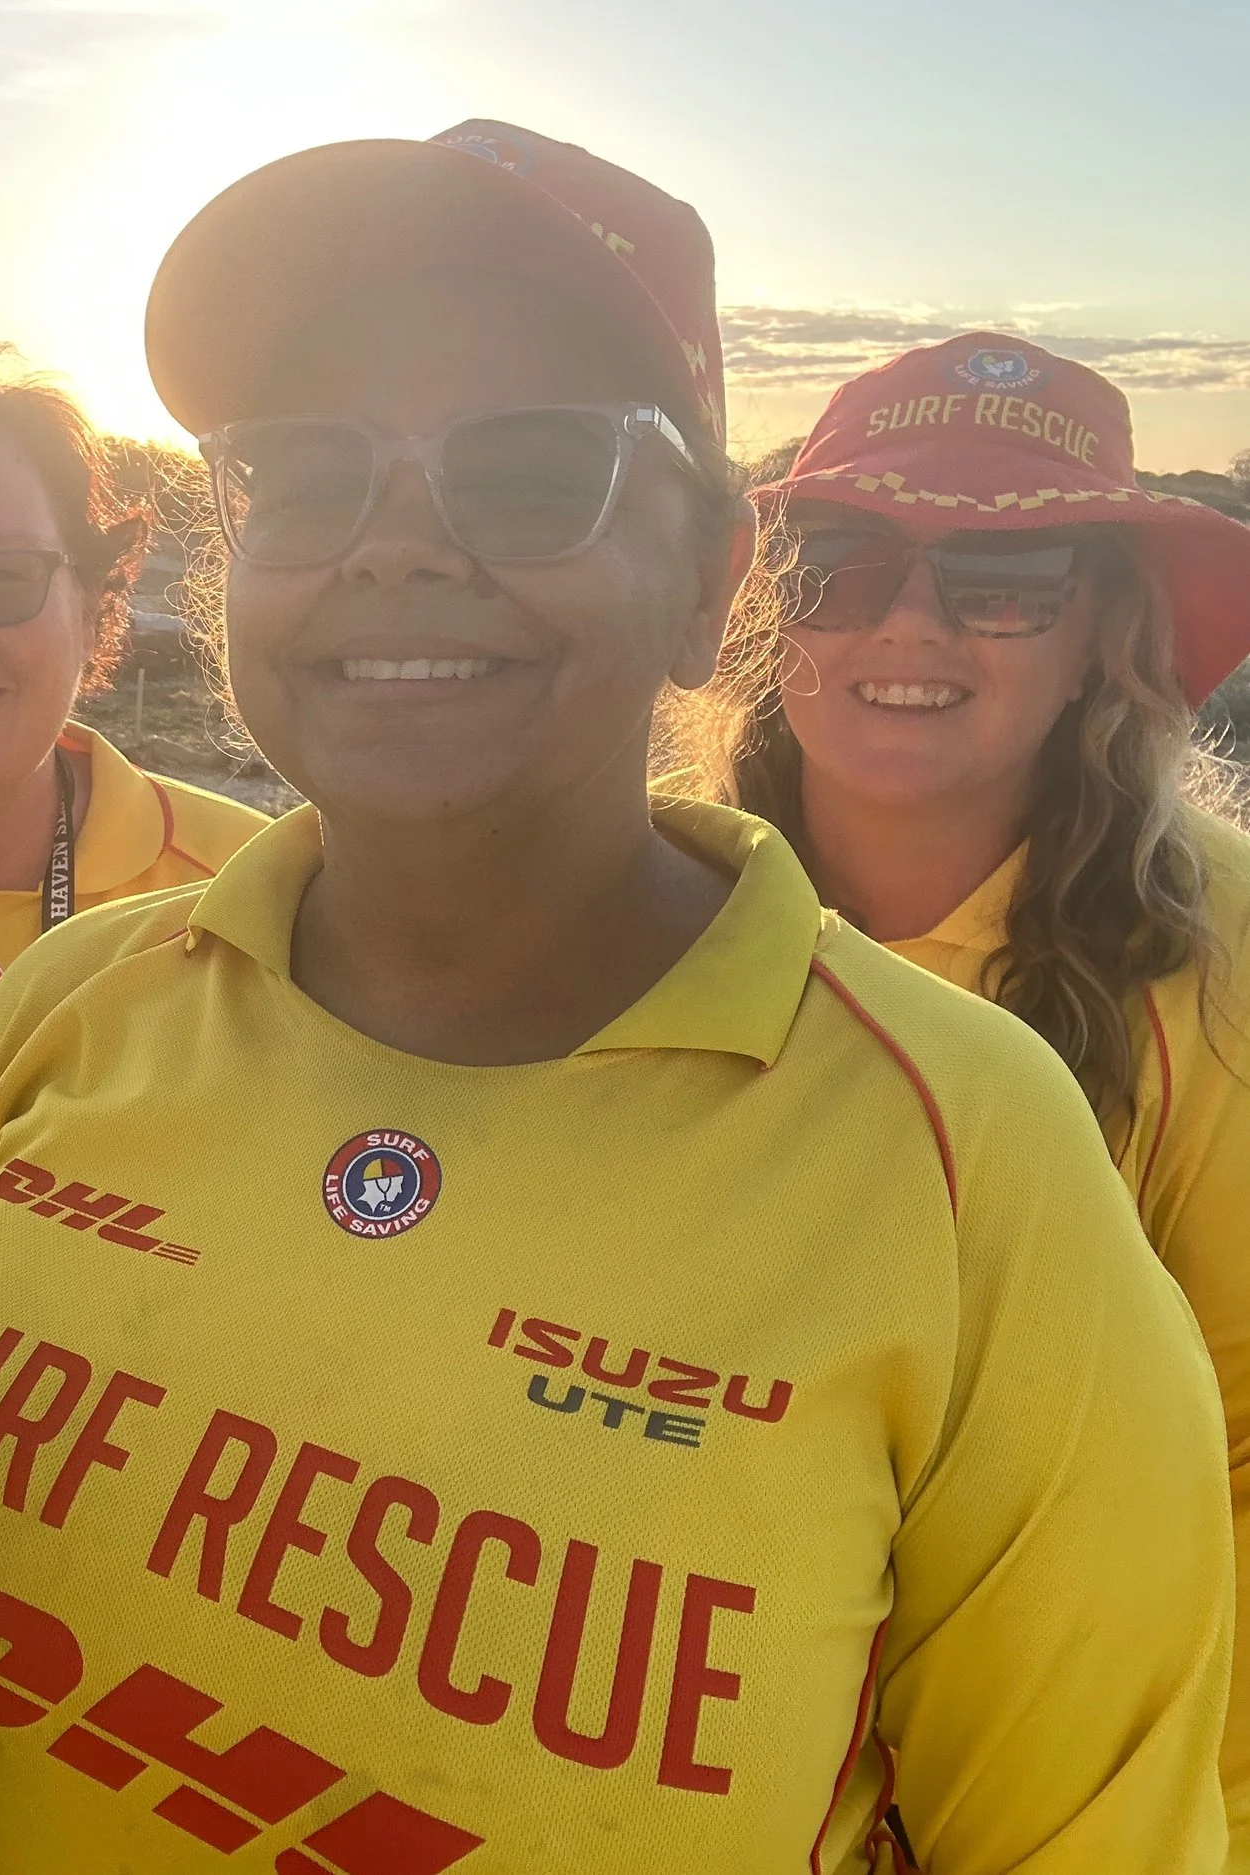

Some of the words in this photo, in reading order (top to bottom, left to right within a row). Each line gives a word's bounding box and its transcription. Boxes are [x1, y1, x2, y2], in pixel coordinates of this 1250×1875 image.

[866, 394, 966, 438] SURF
[975, 394, 1099, 467] RESCUE
[51, 841, 69, 919] HAVEN
[367, 1133, 430, 1161] SURF
[326, 1174, 349, 1221] LIFE
[350, 1198, 430, 1235] SAVING
[487, 1308, 794, 1425] ISUZU
[527, 1375, 705, 1449] UTE
[146, 1409, 756, 1796] RESCUE
